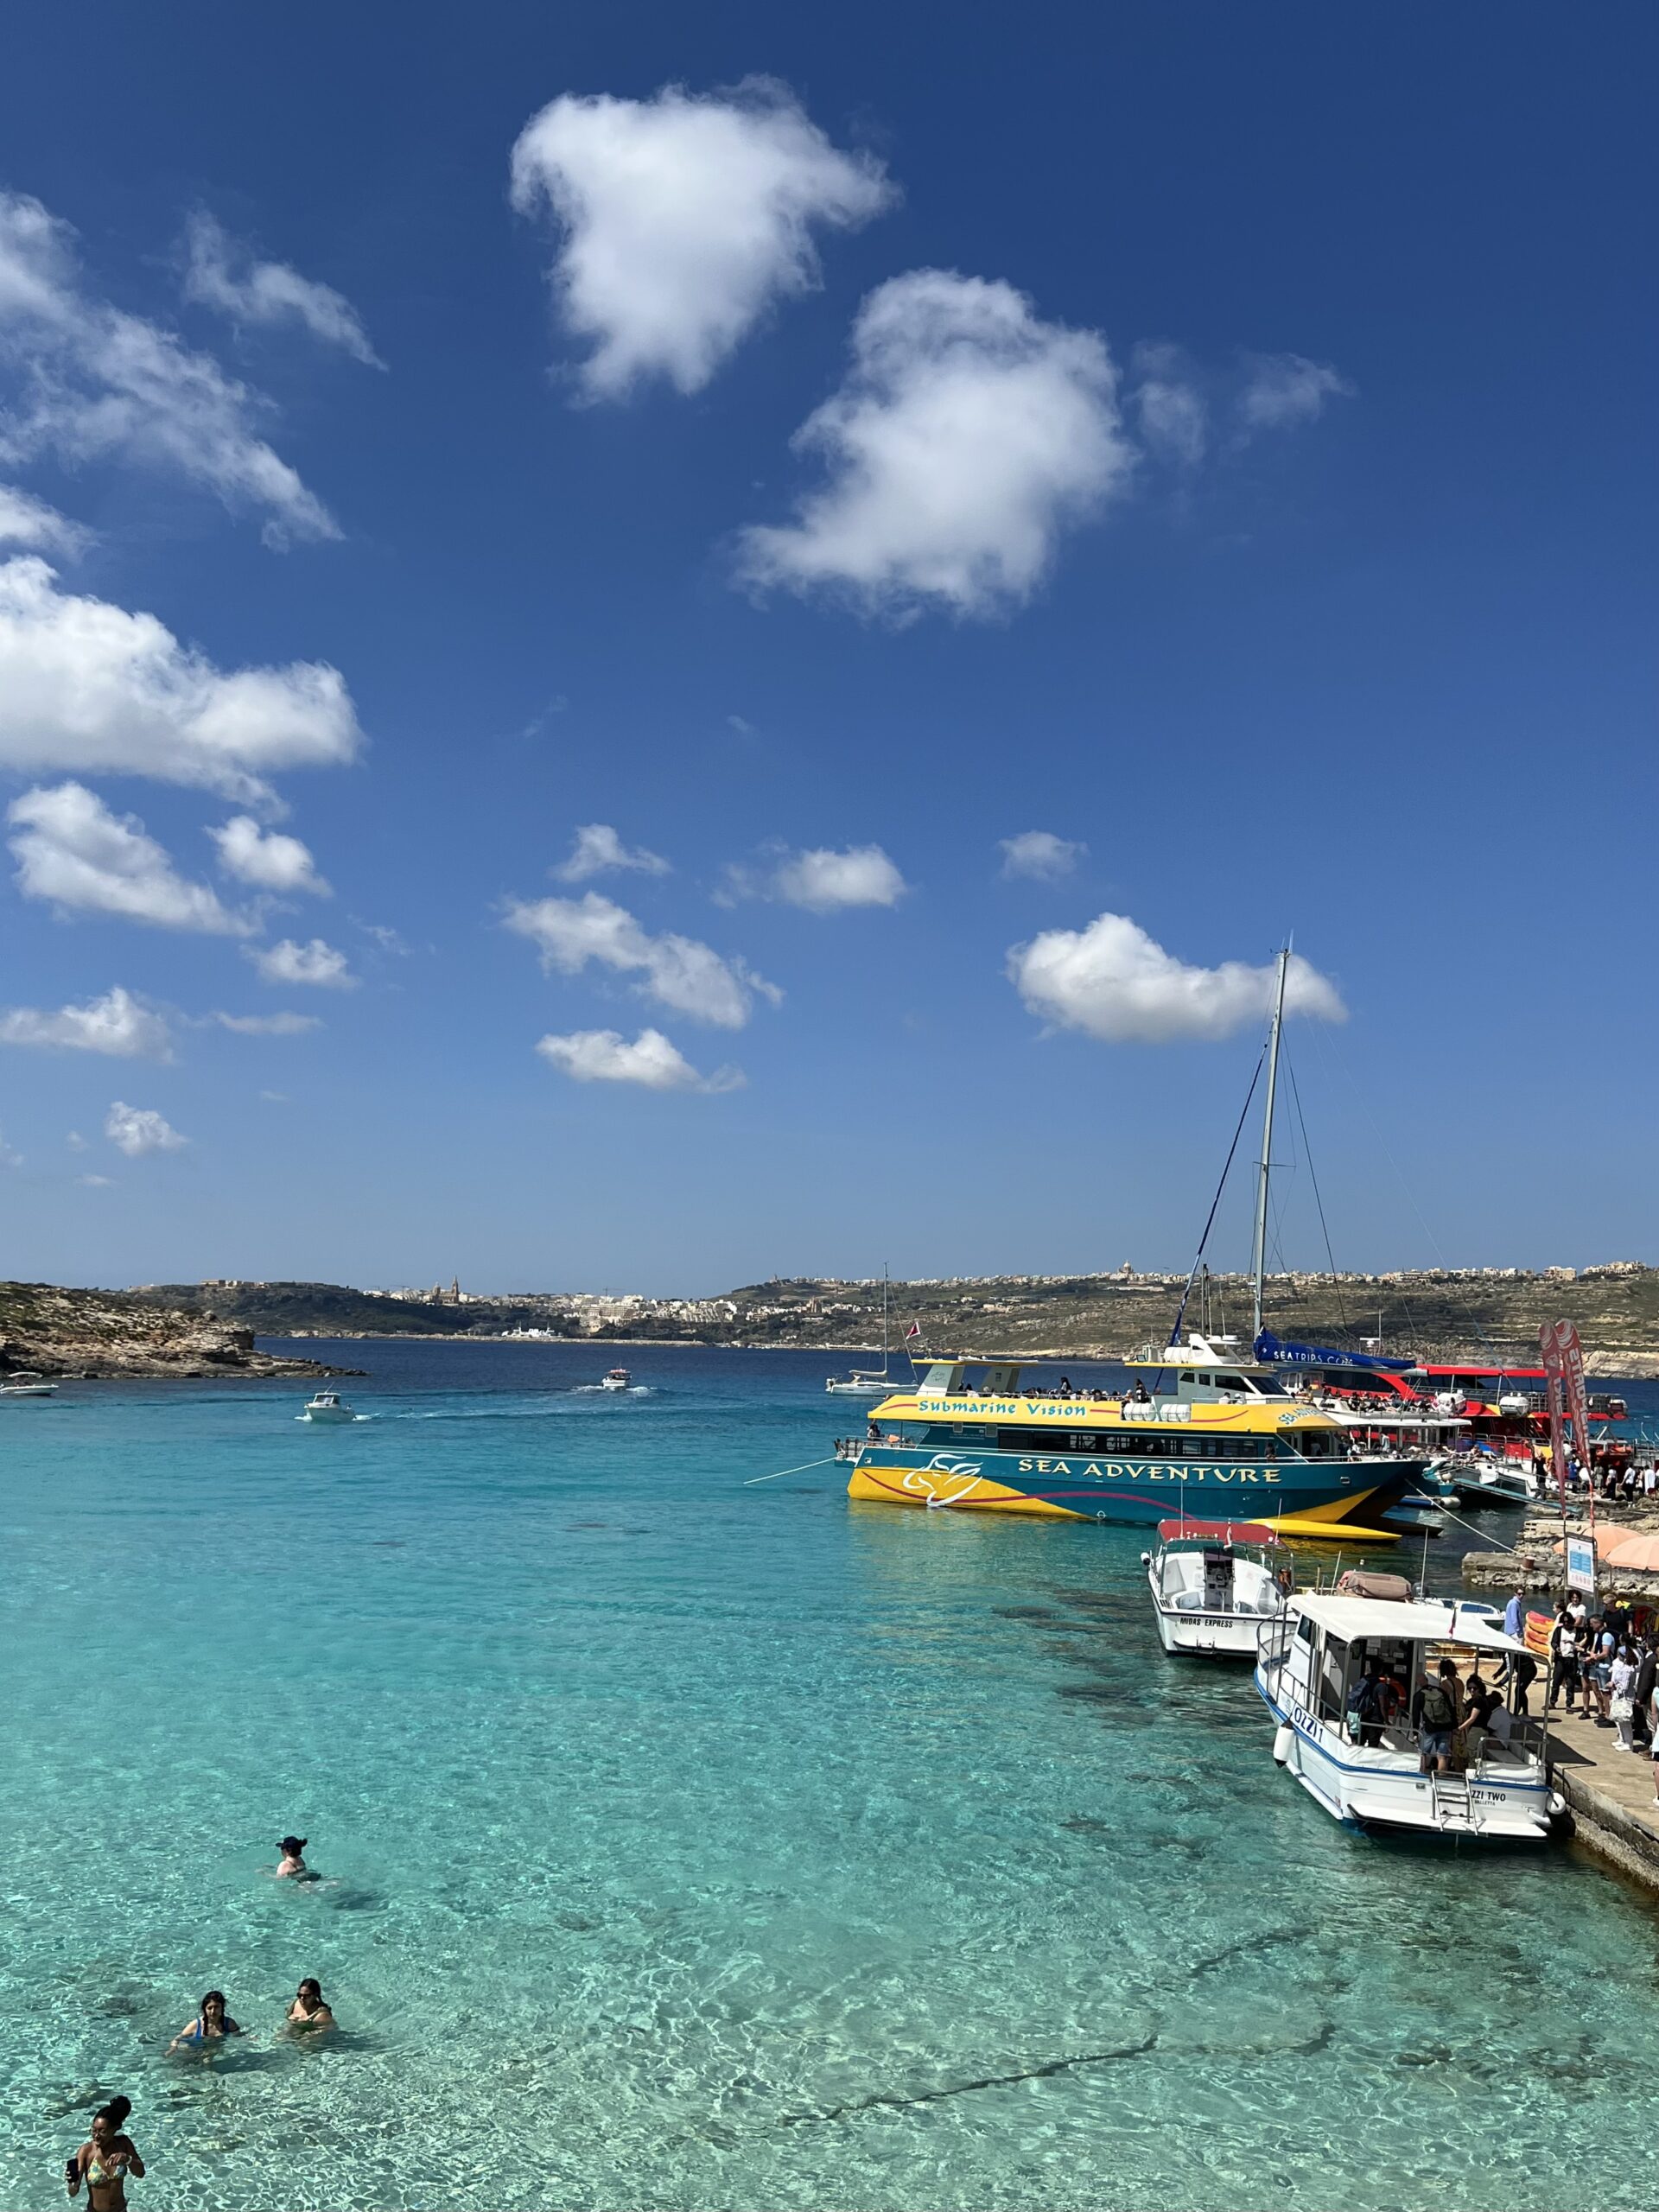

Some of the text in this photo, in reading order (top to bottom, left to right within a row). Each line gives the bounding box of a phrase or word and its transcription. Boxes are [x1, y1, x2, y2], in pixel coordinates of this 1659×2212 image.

[918, 1400, 1086, 1416] Submarine Vision
[1018, 1459, 1282, 1483] SEA ADVENTURE
[1179, 1617, 1233, 1628] MIDAS EXPRESS
[1471, 1789, 1506, 1802] ZZI TWO
